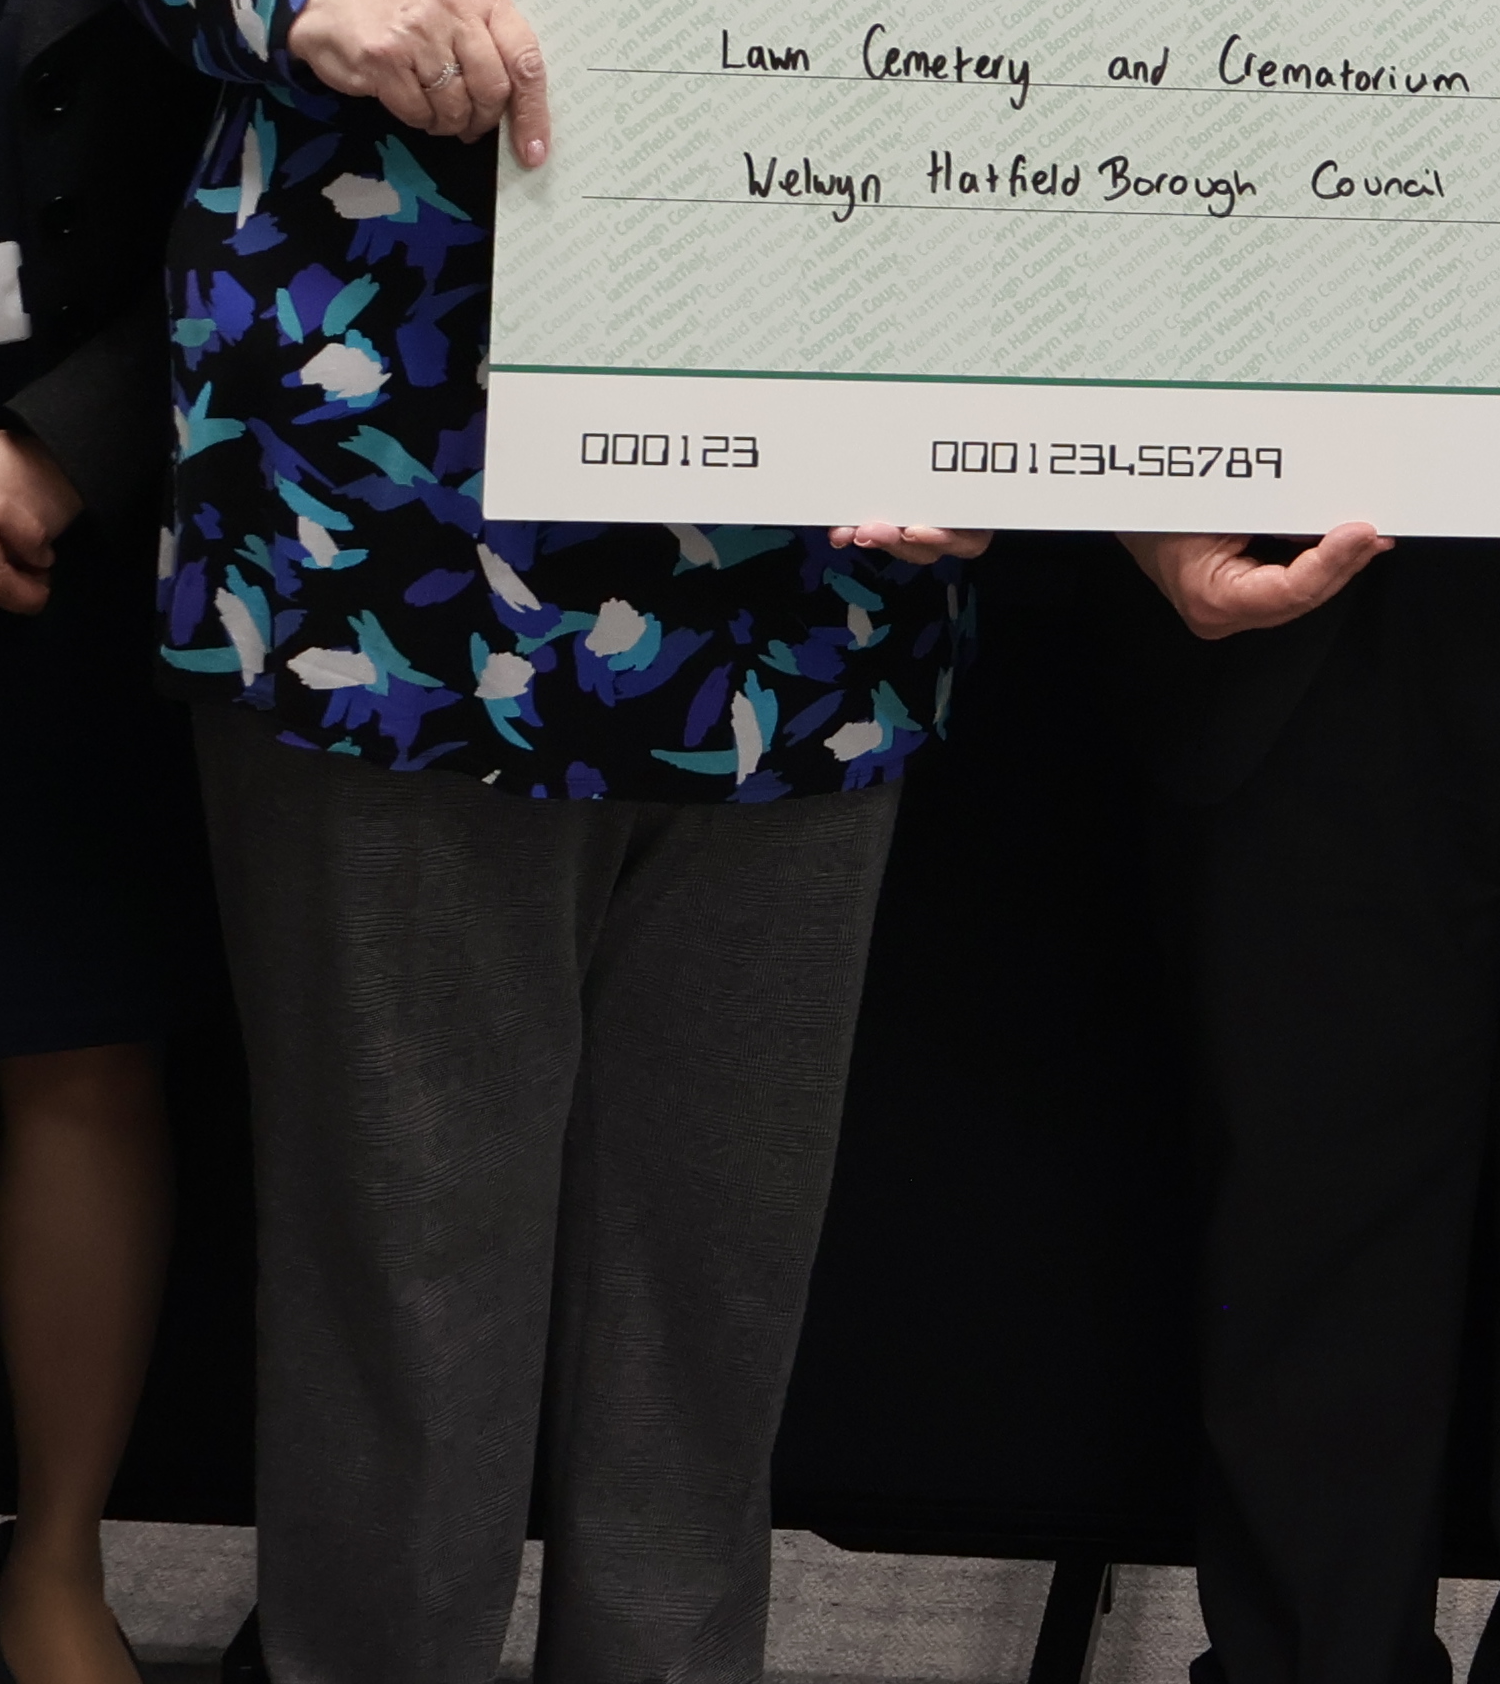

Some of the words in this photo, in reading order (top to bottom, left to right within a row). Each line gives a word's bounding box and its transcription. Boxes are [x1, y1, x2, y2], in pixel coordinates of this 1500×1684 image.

[722, 28, 810, 71] Lawn
[863, 23, 1030, 110] Cemetery
[1108, 47, 1170, 86] and
[1218, 34, 1471, 94] Crematorium
[744, 151, 882, 223] Welwyn
[927, 149, 1080, 198] Hatfield
[1101, 155, 1256, 218] Borough
[1311, 158, 1445, 200] Council
[580, 433, 760, 469] 000123
[931, 439, 1282, 480] 000123456789
